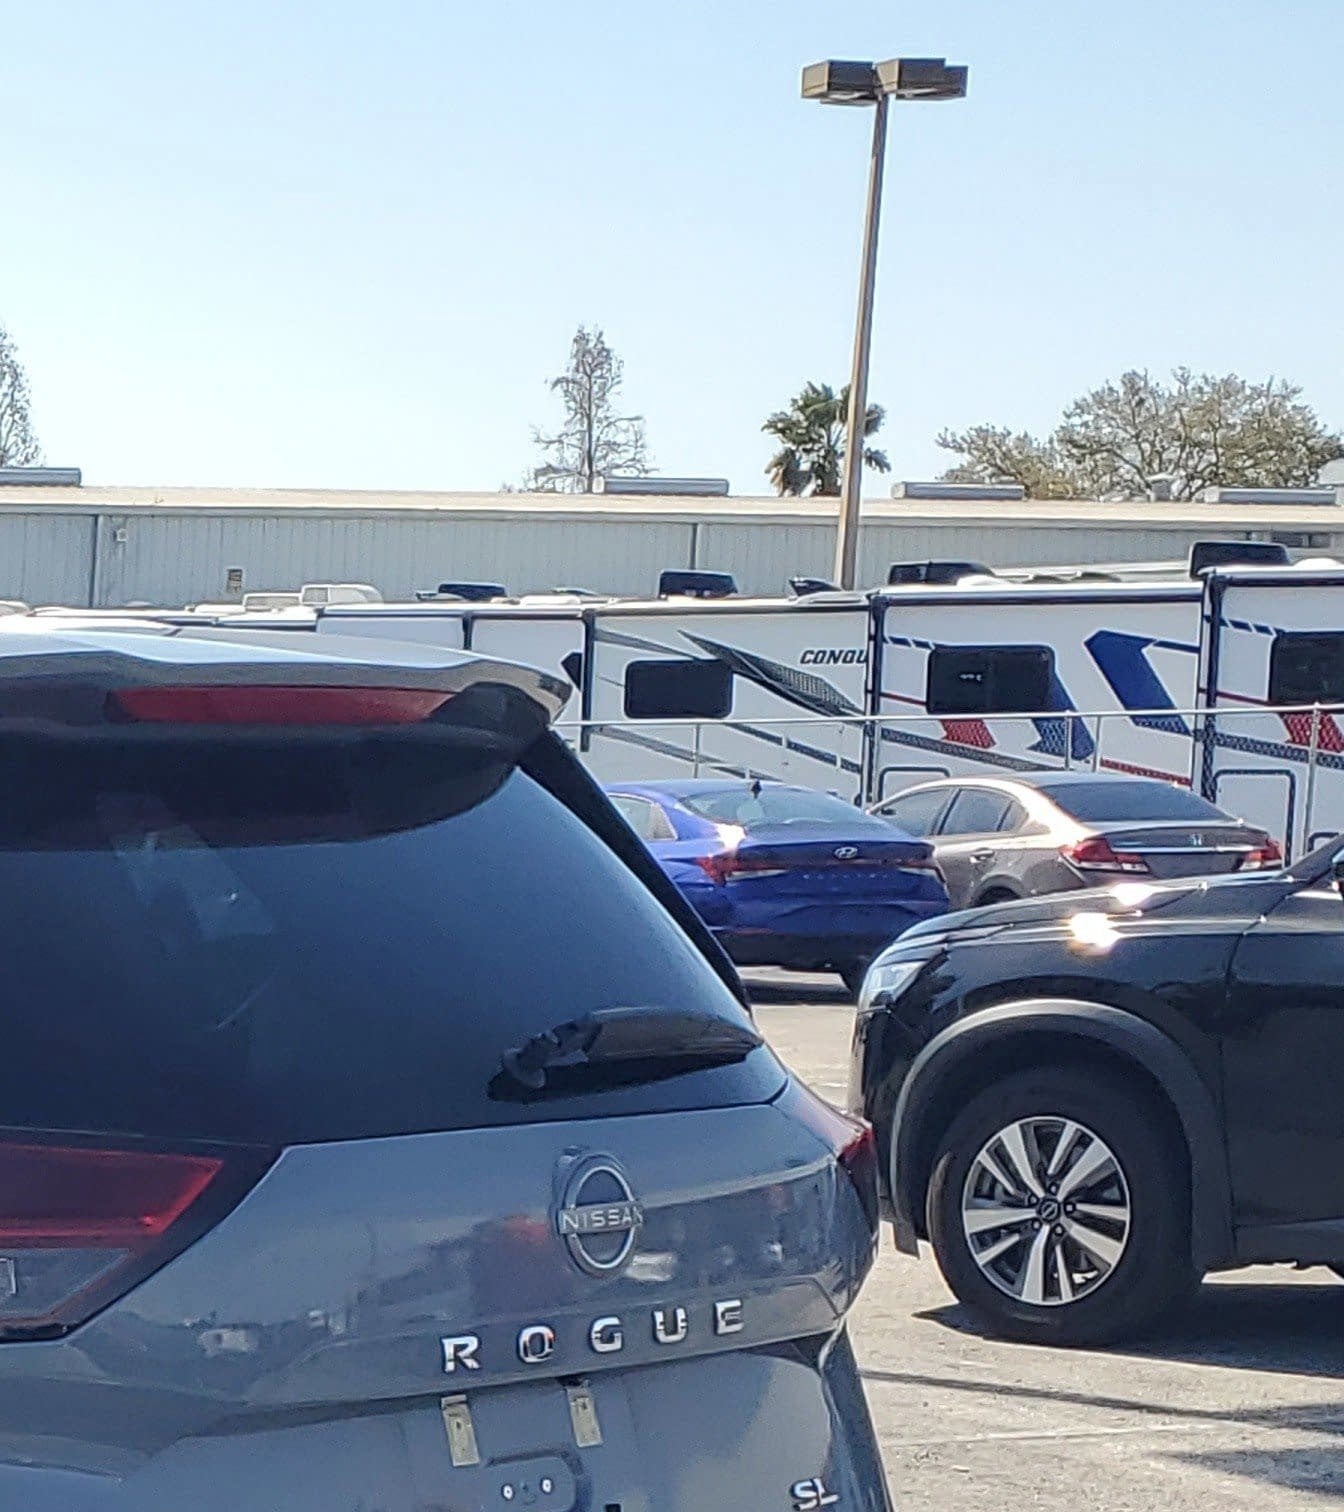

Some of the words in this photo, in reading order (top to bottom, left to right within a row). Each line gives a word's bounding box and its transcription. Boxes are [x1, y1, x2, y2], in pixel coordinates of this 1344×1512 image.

[561, 1206, 644, 1232] NISSAN
[442, 1299, 745, 1373] ROGUE
[792, 1477, 839, 1512] SL
